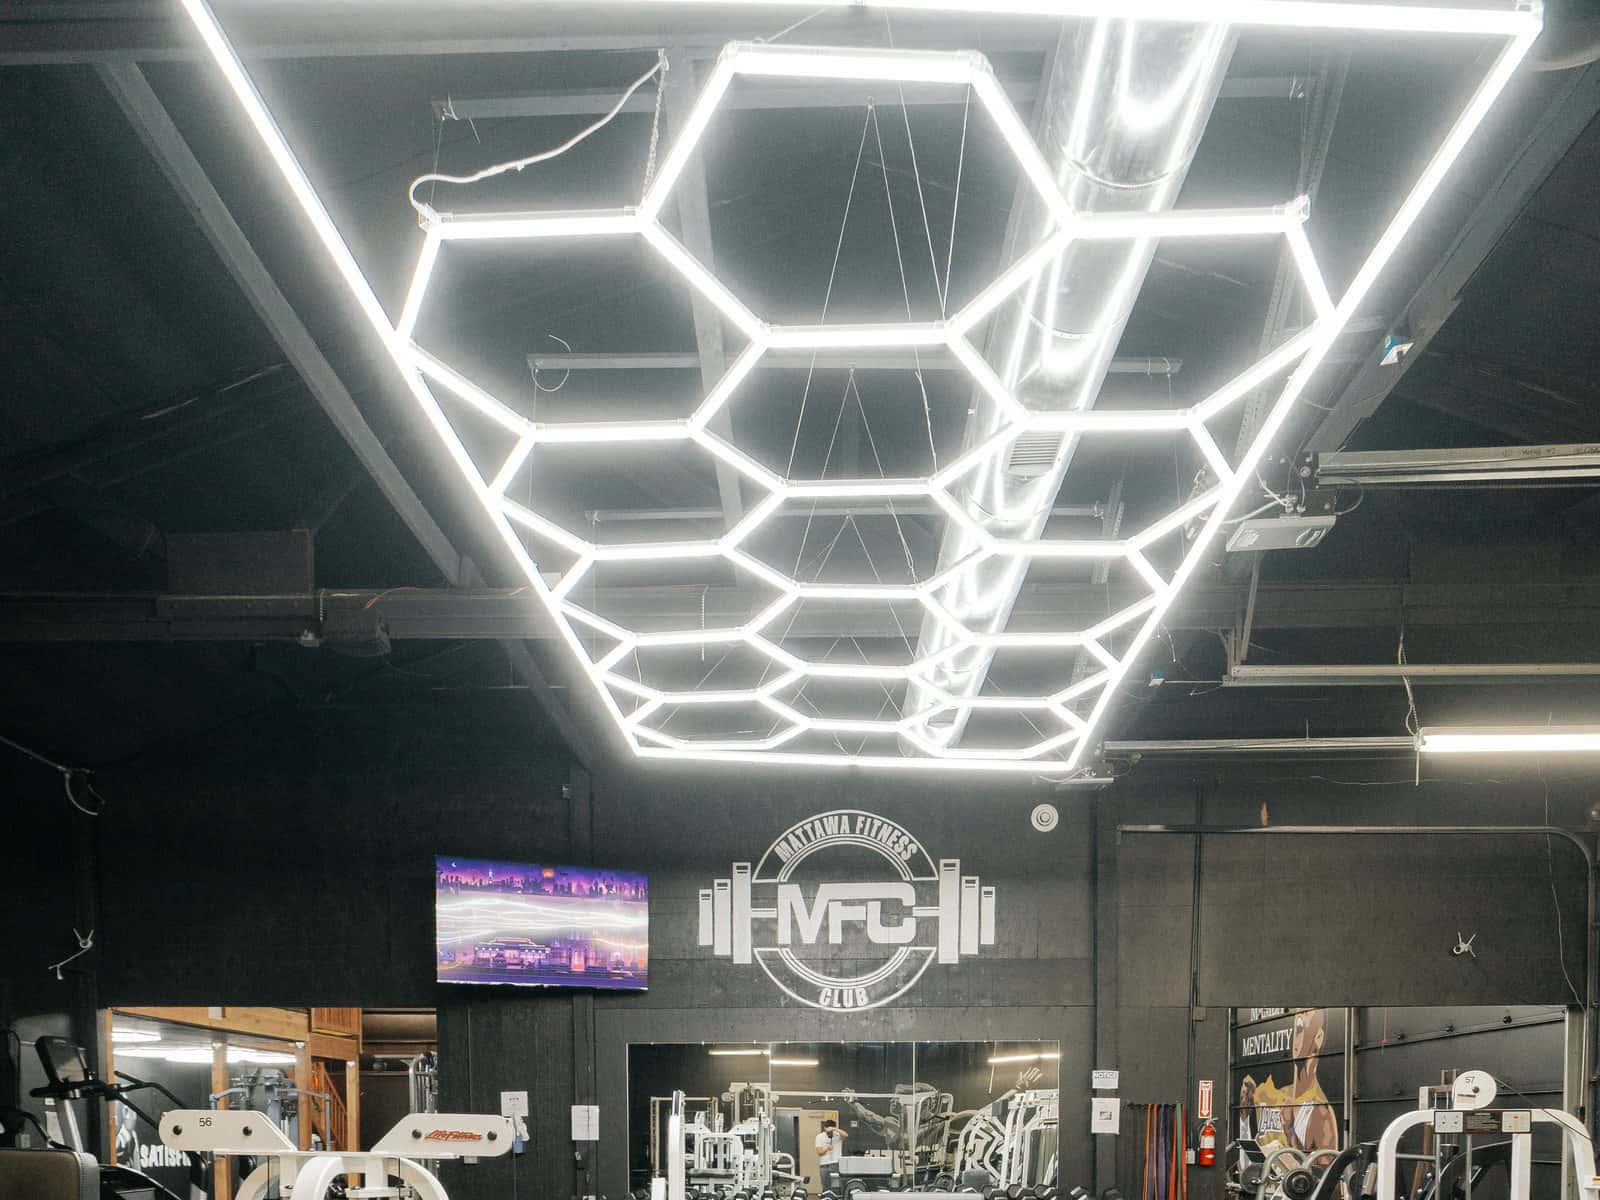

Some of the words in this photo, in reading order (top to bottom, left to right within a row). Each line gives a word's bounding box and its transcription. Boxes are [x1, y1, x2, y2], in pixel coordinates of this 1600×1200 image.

[775, 815, 850, 863] MATTAWA
[856, 815, 918, 861] FITNESS
[778, 882, 916, 944] MFC
[818, 987, 869, 1008] CLUB
[1242, 1028, 1293, 1057] MENTALITY
[1465, 1076, 1475, 1085] 57
[200, 1117, 212, 1127] 56
